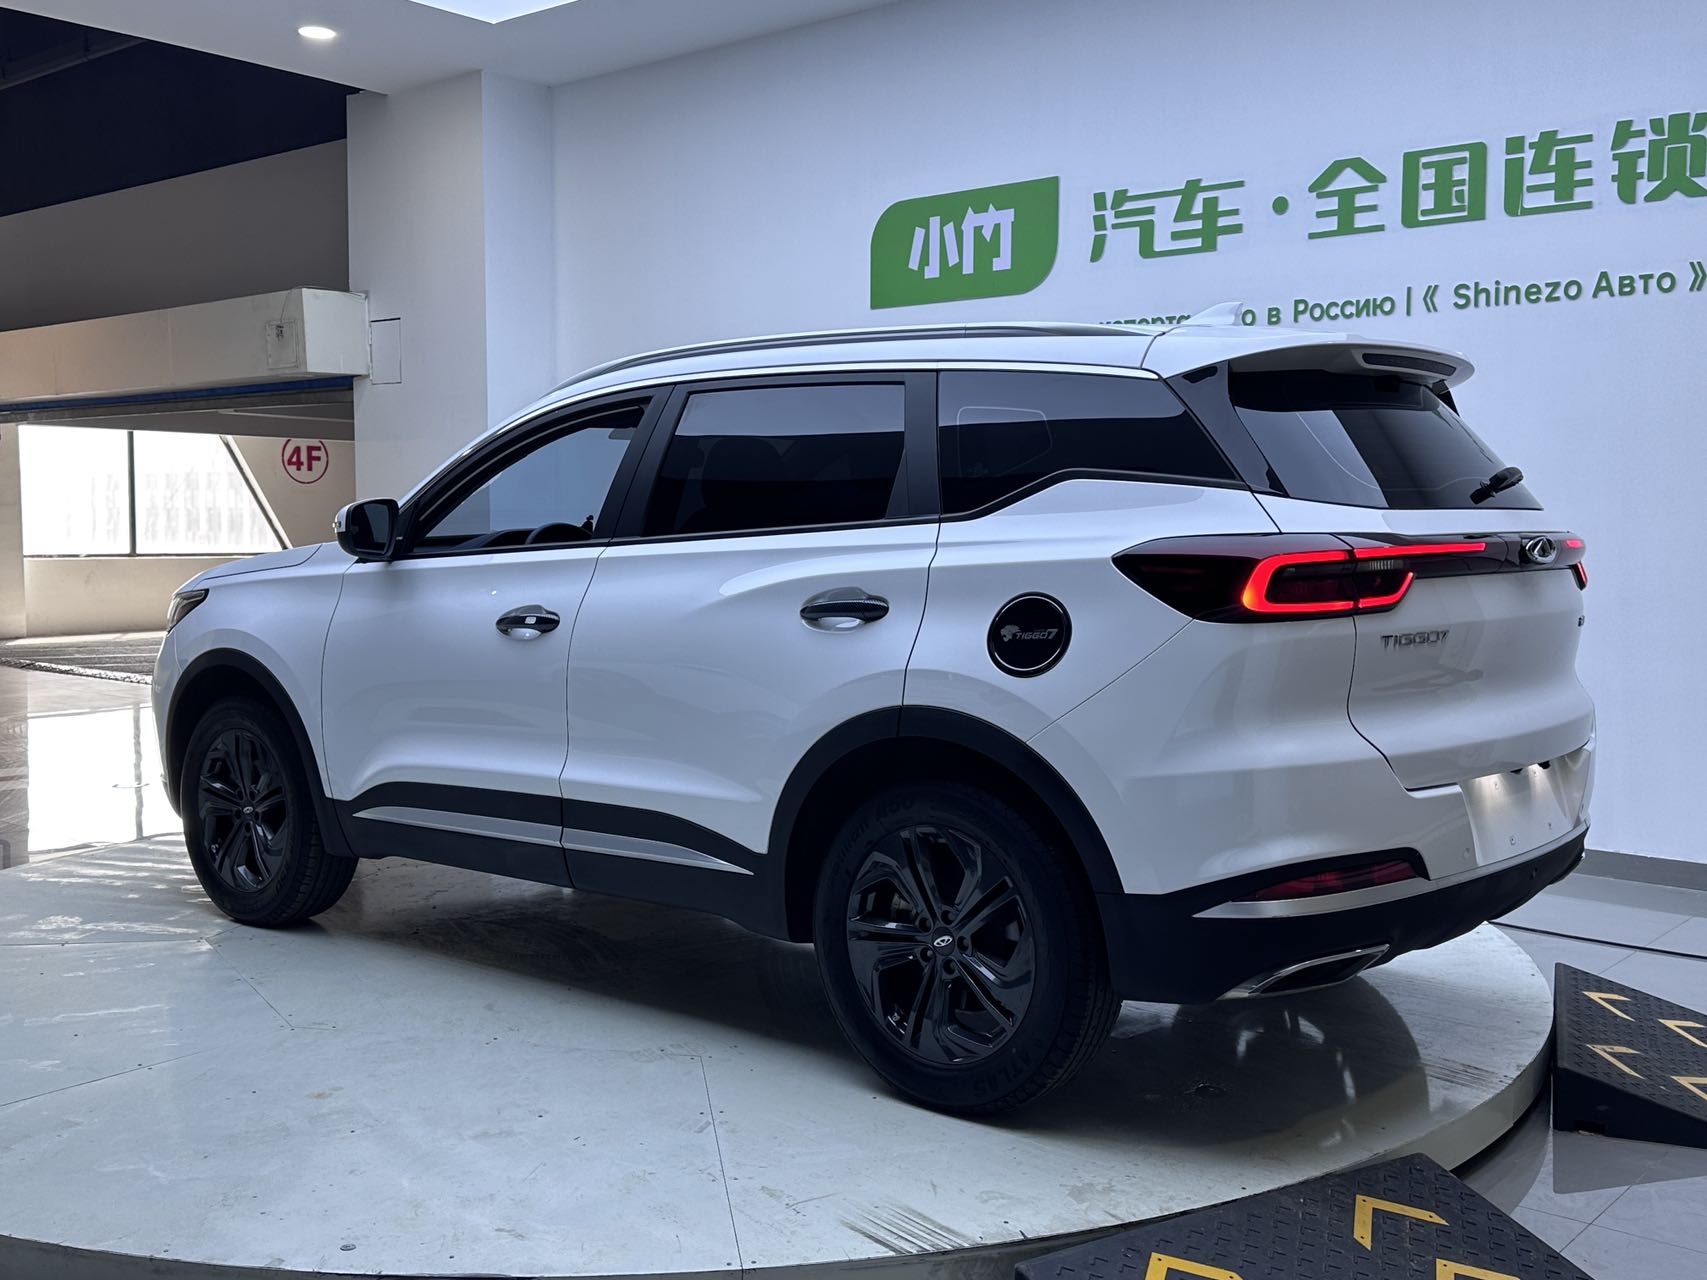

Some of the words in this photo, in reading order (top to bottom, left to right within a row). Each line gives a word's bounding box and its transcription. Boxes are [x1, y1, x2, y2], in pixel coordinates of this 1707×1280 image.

[908, 203, 1015, 279] 小竹
[1293, 296, 1397, 323] Россию
[1453, 279, 1583, 310] Shinezo
[1592, 270, 1677, 299] Авто
[287, 445, 322, 472] 4F
